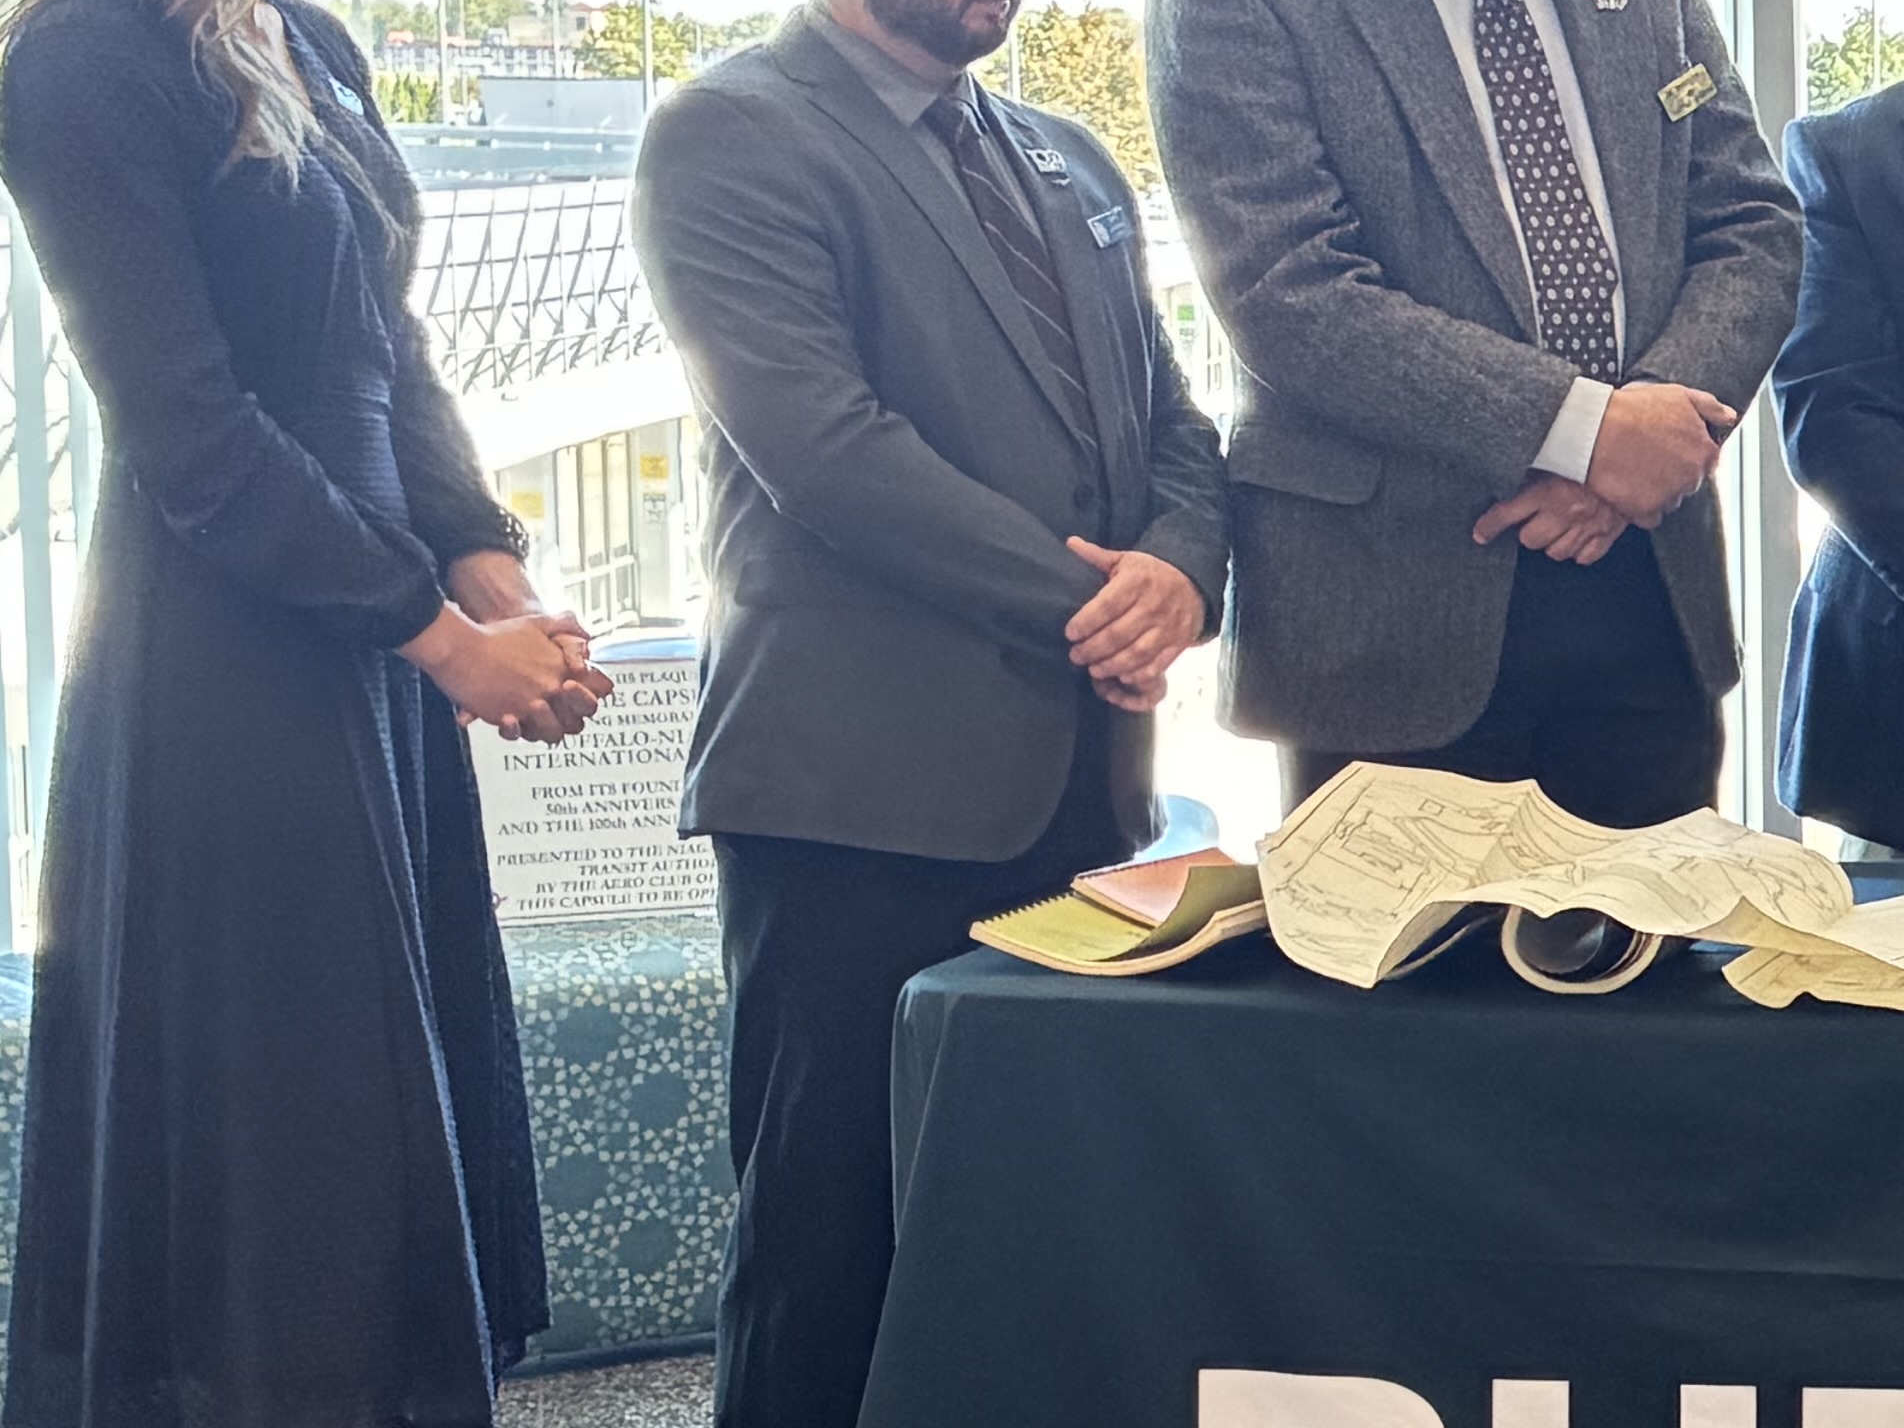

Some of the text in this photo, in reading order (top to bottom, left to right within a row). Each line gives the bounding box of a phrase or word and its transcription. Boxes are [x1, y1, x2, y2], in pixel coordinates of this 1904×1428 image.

[531, 784, 584, 800] FROM
[498, 821, 539, 836] AND
[600, 847, 624, 860] TO
